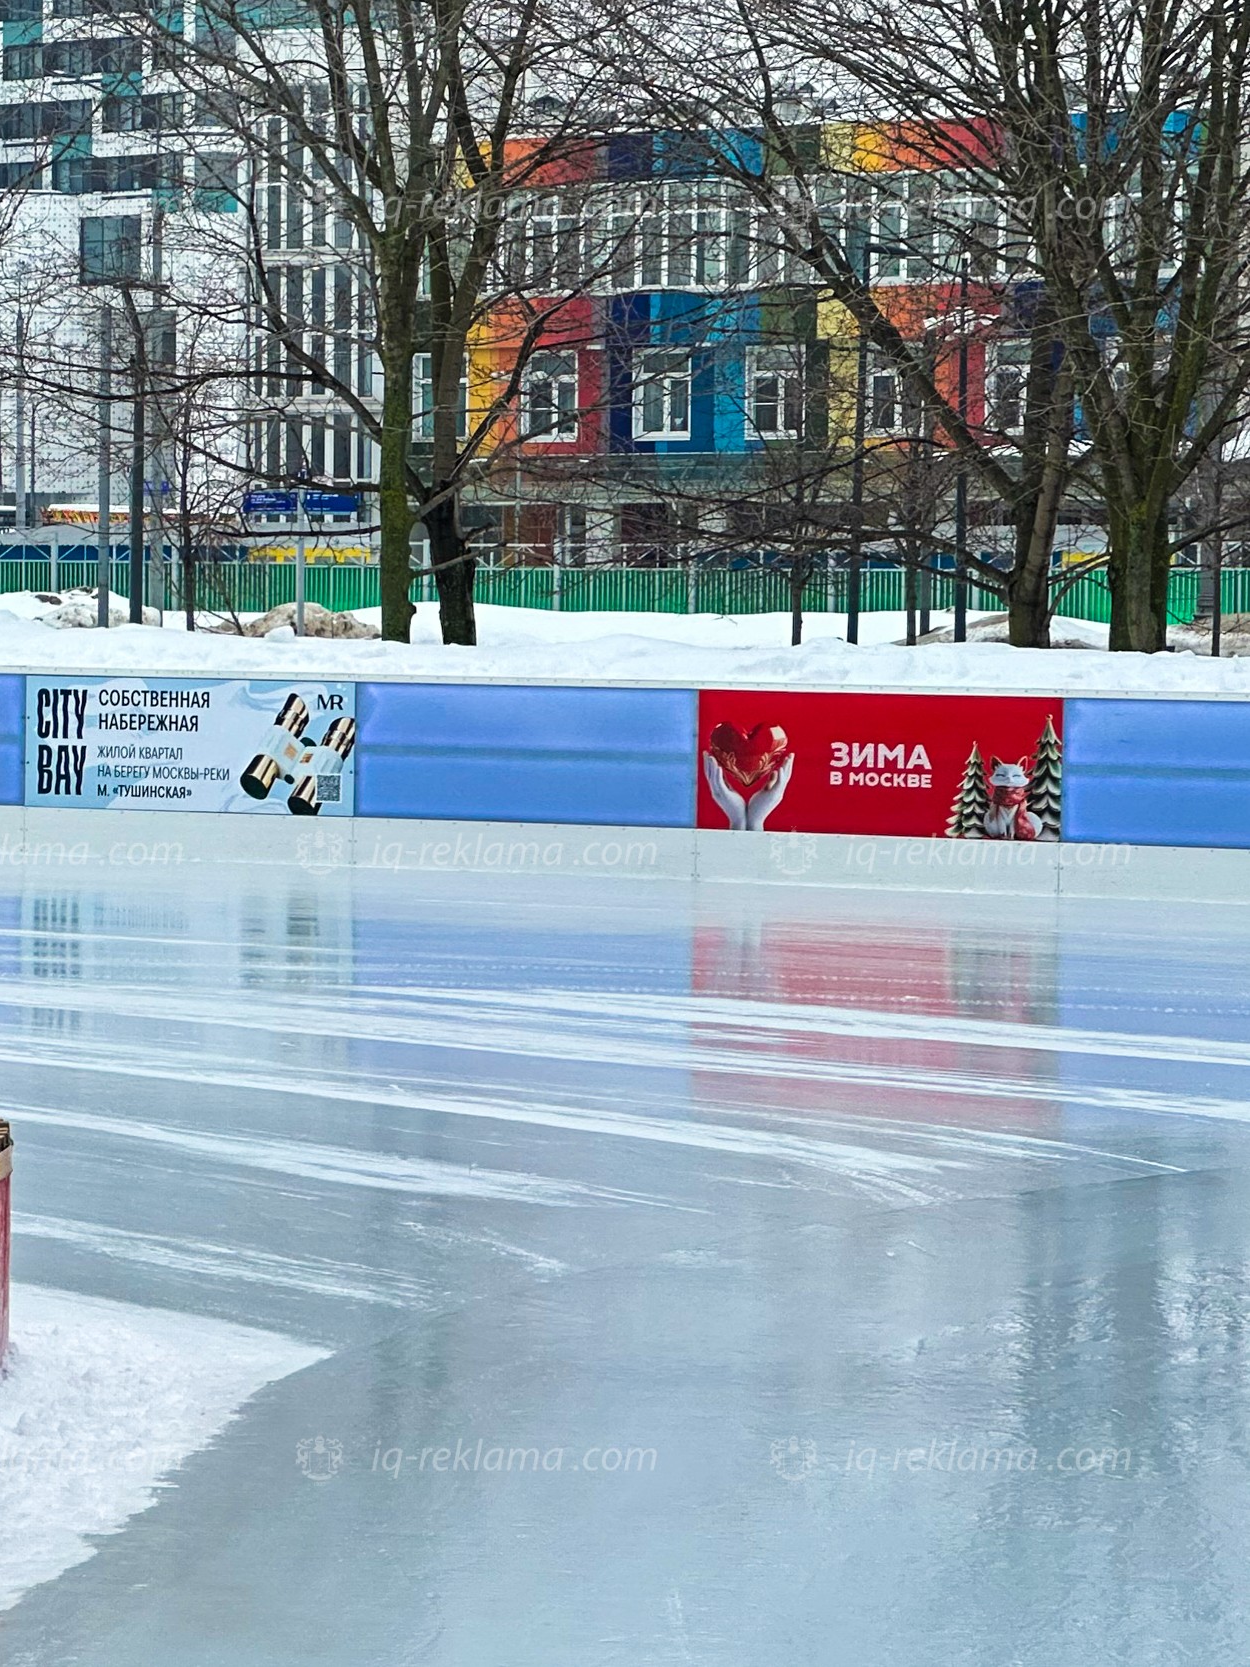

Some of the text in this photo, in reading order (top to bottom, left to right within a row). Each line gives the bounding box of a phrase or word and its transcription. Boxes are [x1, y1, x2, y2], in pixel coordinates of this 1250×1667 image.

[99, 689, 210, 709] СОБСТВЕННАЯ
[317, 694, 344, 711] MR
[37, 688, 88, 739] CITY
[99, 713, 199, 732] НАБЕРЕЖНАЯ
[97, 744, 183, 760] ЖИЛОЙ КВАРТАЛ
[830, 741, 932, 770] ЗИМА
[37, 744, 87, 796] BAY
[97, 766, 230, 781] НА БЕРЕГУ МОСКВЫ-РЕКИ
[830, 771, 933, 788] В МОСКВЕ
[97, 784, 192, 799] М. «ТУШИНСКАЯ»
